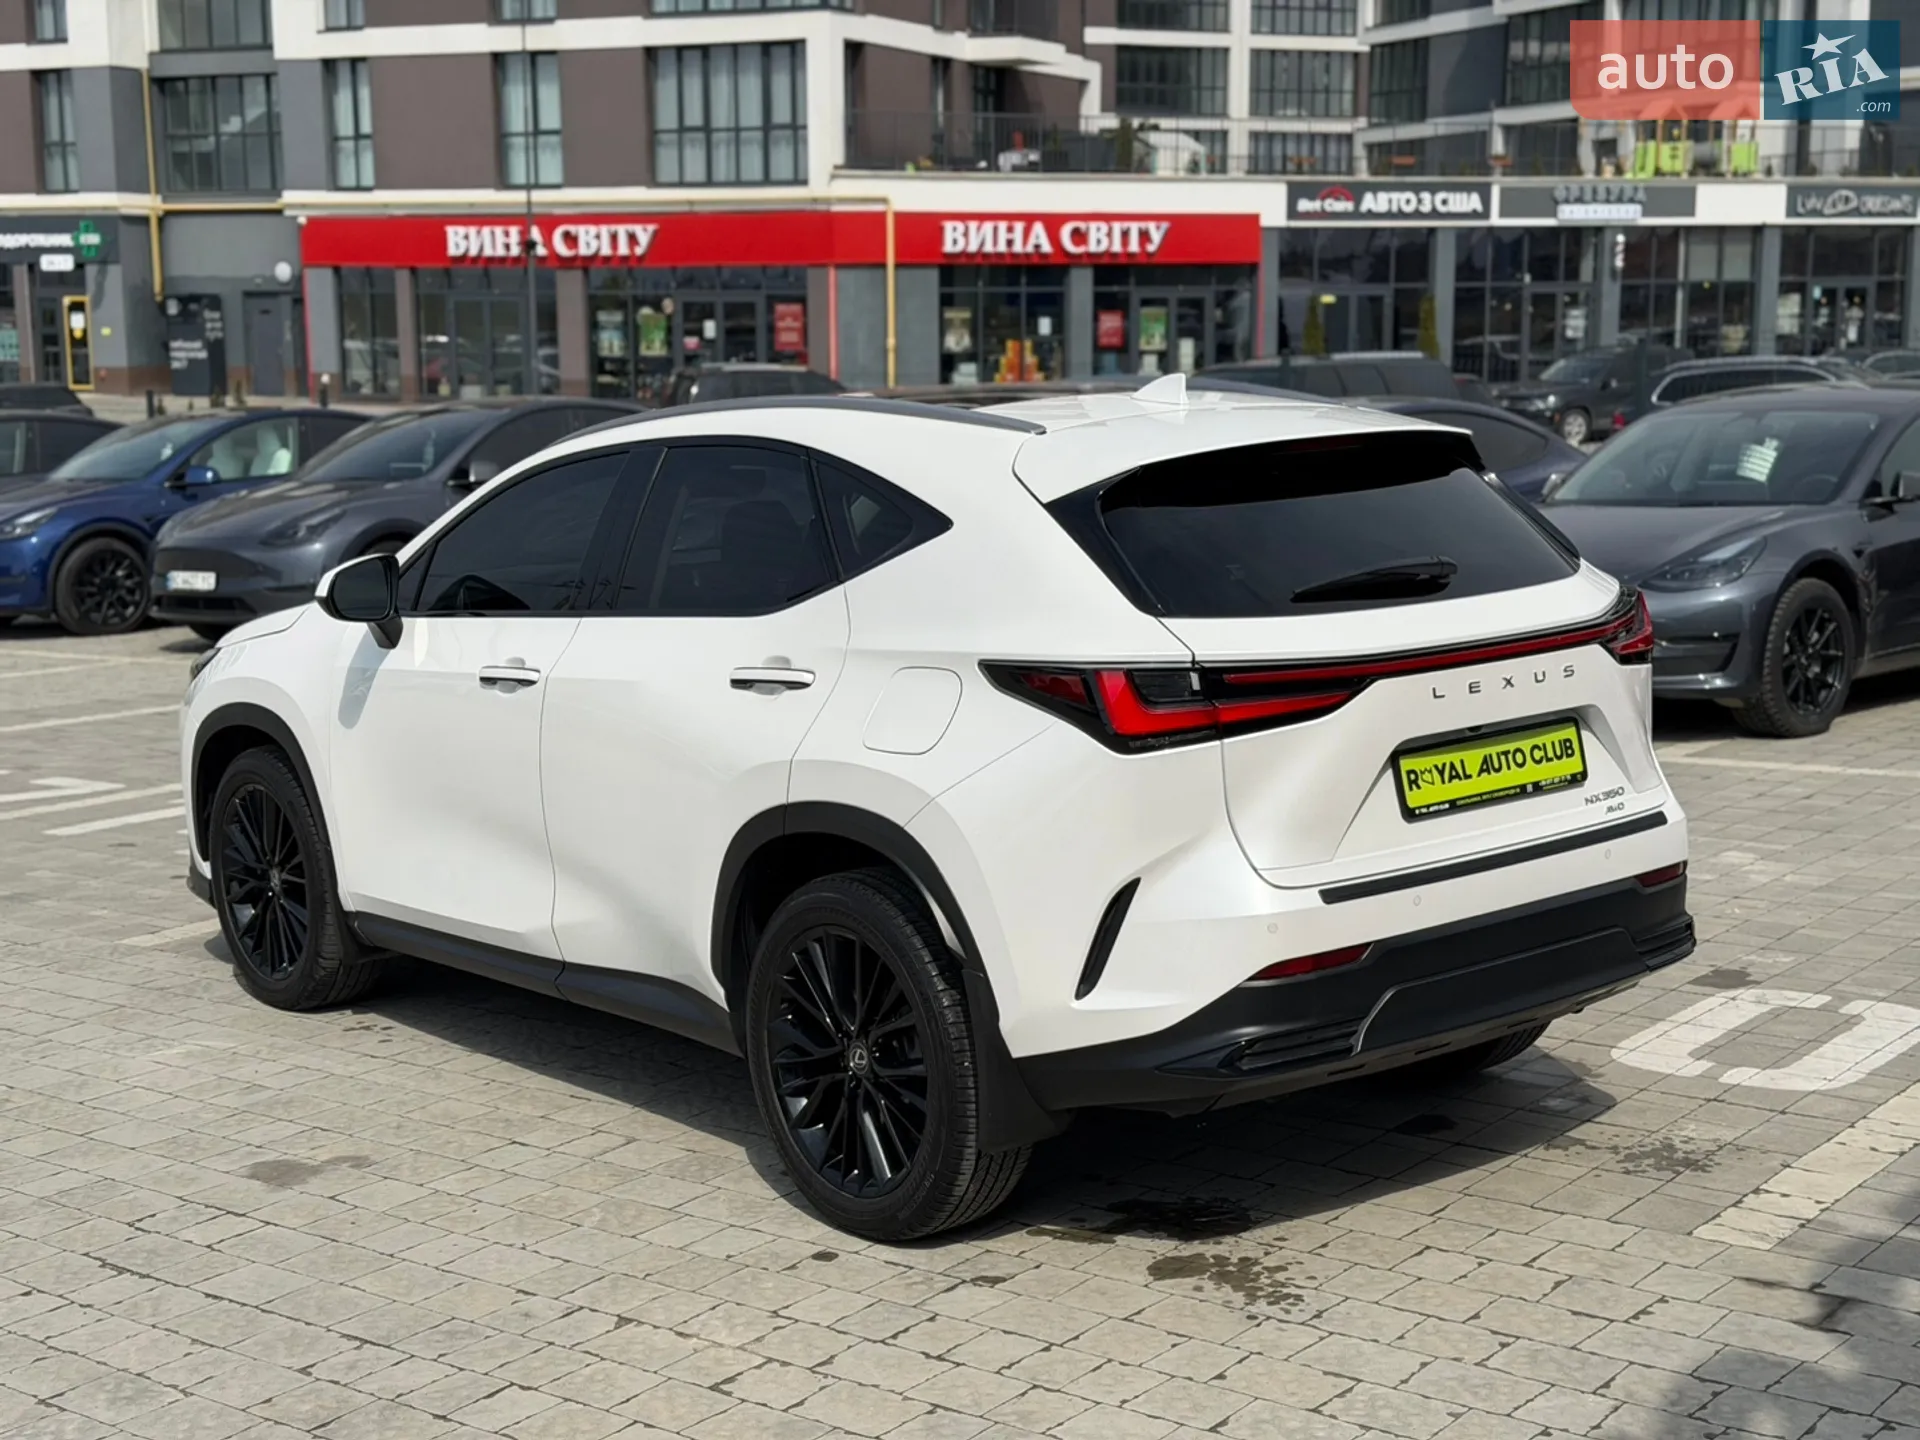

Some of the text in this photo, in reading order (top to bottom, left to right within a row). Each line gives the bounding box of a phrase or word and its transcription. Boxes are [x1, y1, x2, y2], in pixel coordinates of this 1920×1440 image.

[1359, 191, 1418, 214] АВТО
[1433, 191, 1484, 214] США
[444, 223, 659, 258] ВИНА СВІТУ
[941, 219, 1170, 255] ВИНА СВІТУ
[1432, 664, 1576, 699] LEXUS
[1477, 747, 1527, 779] AUTO
[1529, 736, 1576, 766] CLUB
